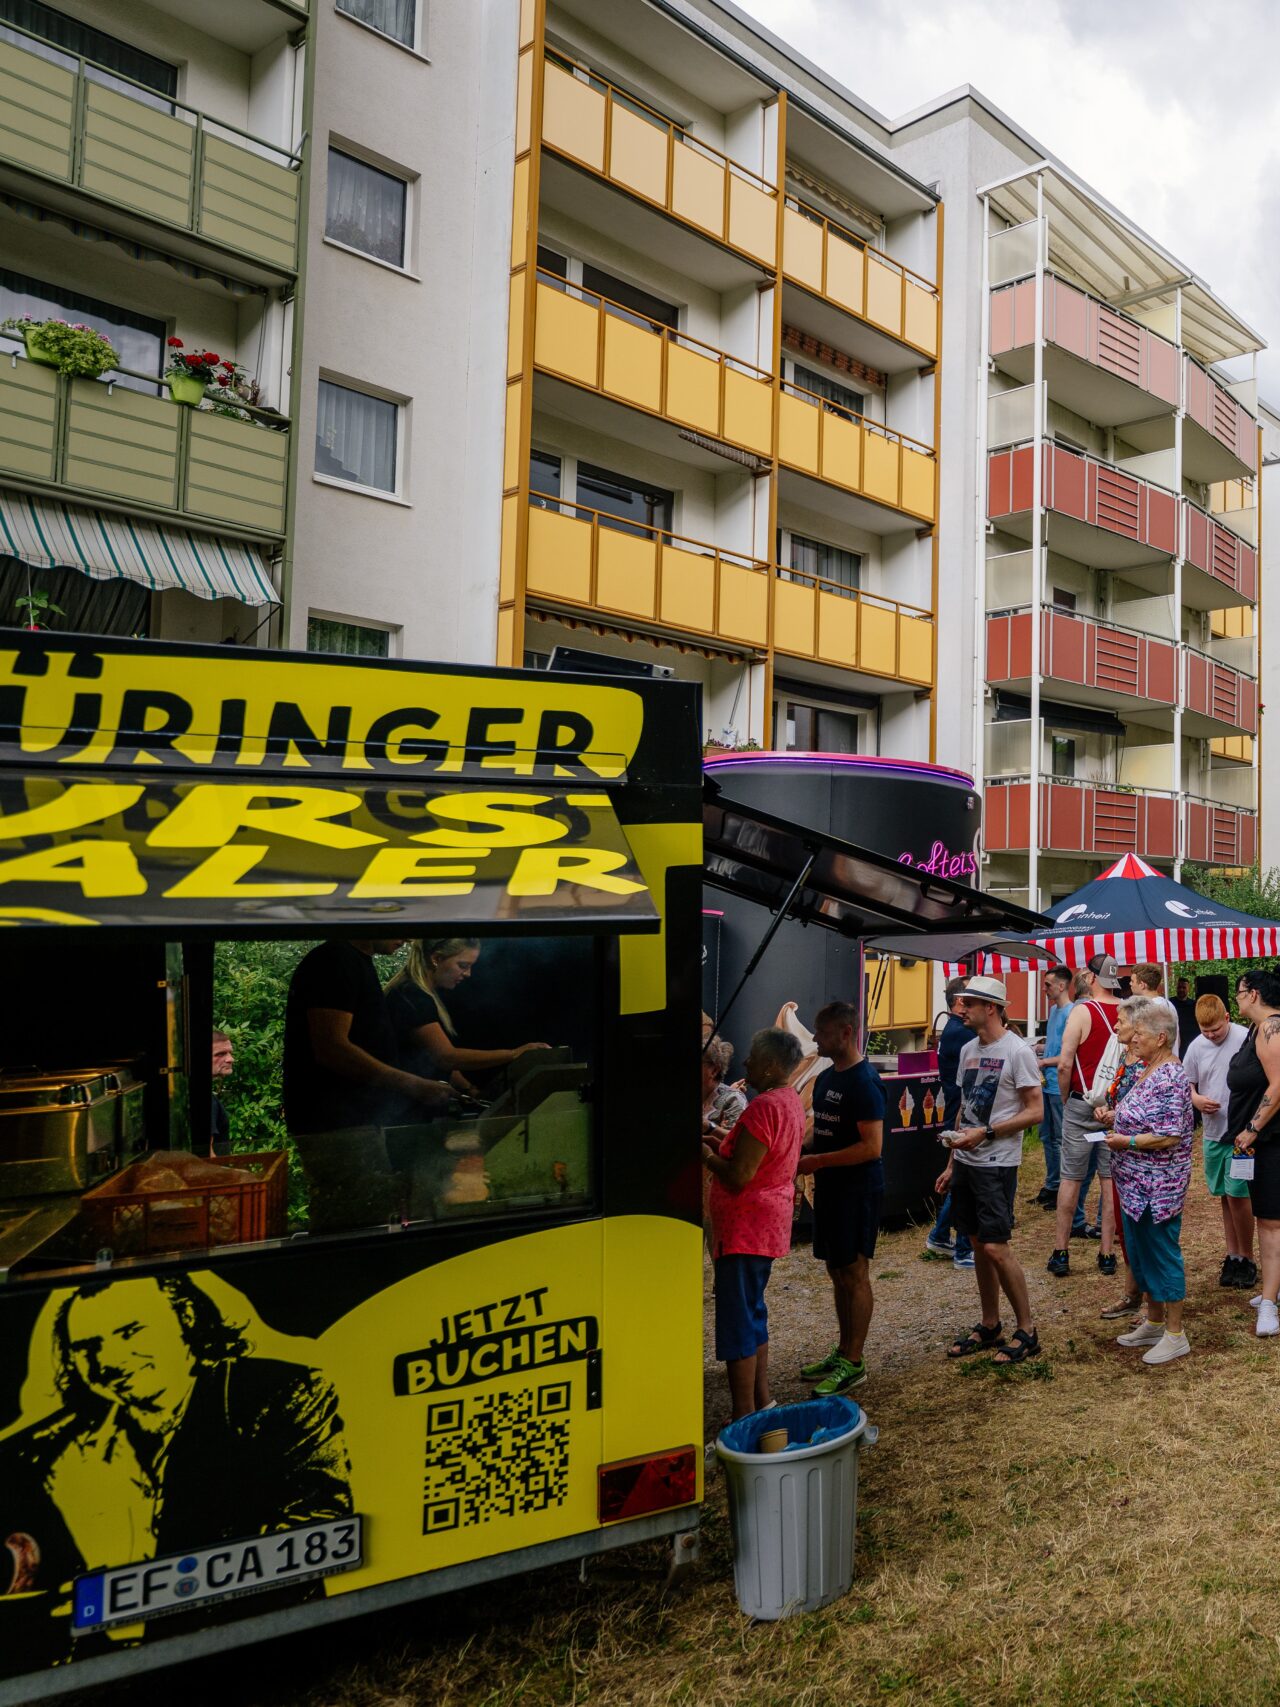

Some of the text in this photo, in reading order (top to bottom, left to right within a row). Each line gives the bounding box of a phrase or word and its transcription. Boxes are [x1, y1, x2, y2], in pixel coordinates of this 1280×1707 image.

[429, 1286, 549, 1348] JETZT
[407, 1321, 587, 1395] BUCHEN
[109, 1523, 355, 1614] EF CA 183
[84, 1604, 95, 1618] D
